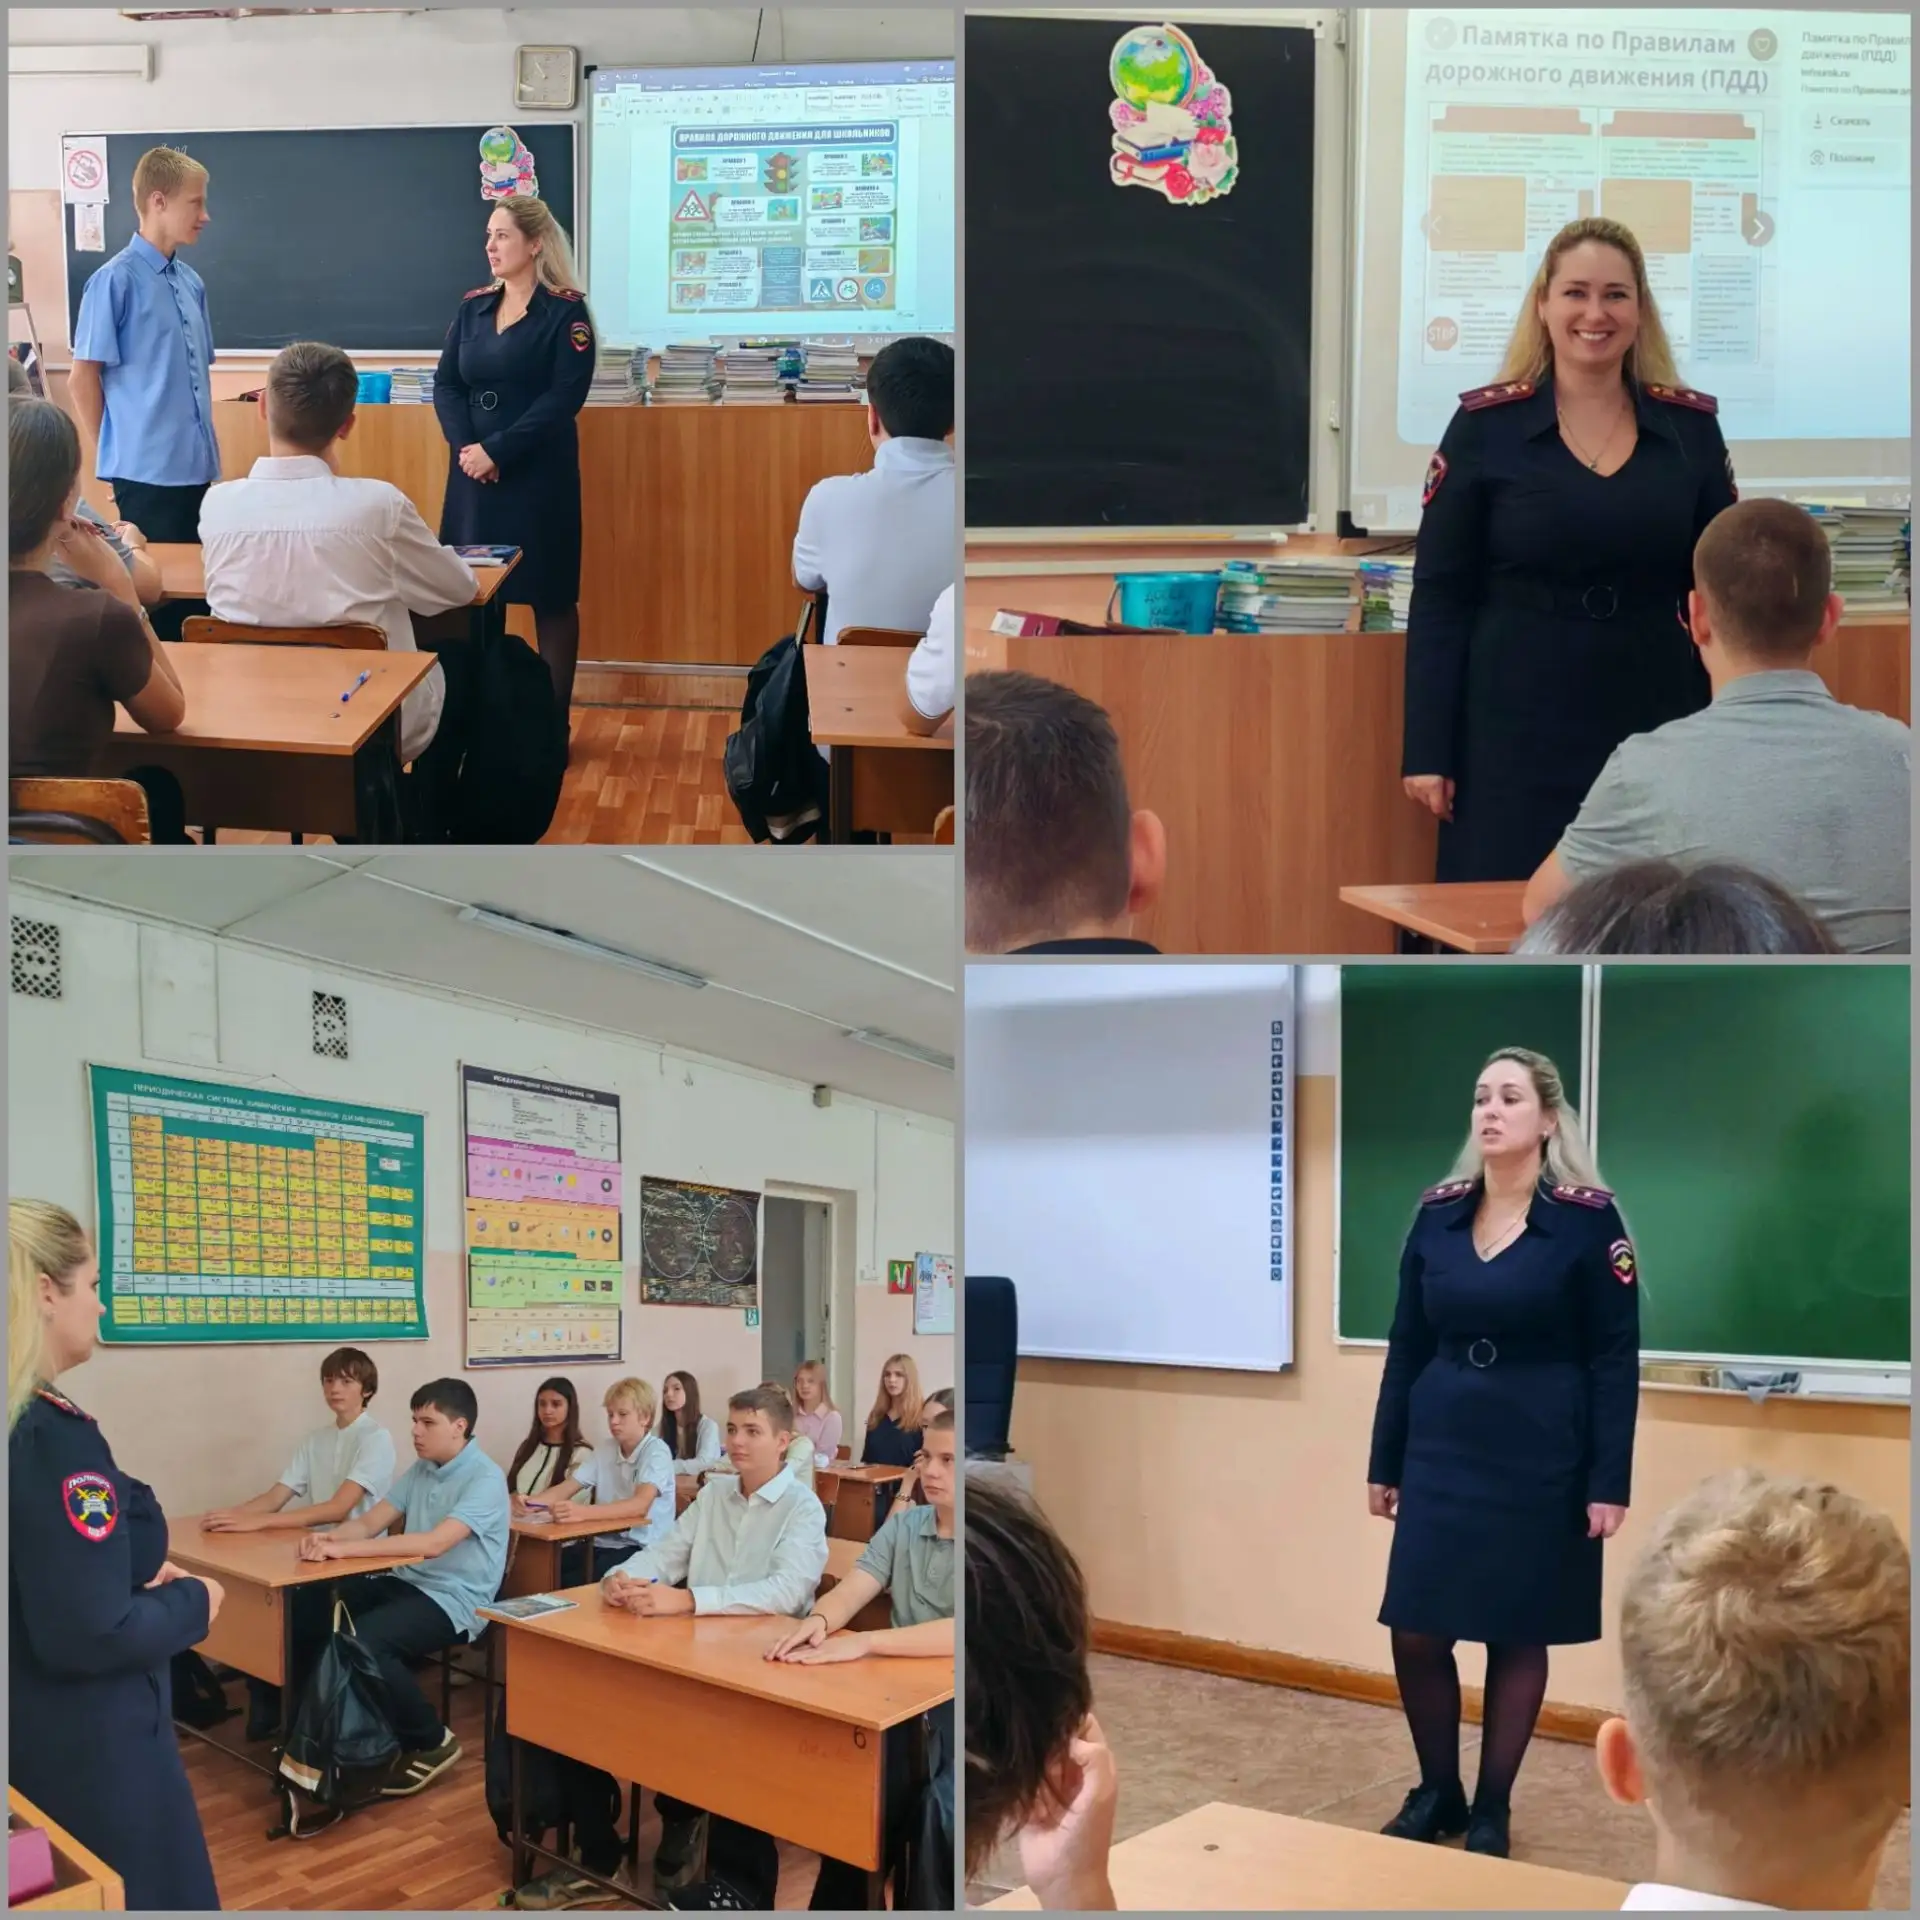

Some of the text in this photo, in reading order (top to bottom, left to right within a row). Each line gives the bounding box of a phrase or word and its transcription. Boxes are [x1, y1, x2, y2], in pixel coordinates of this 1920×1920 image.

[1462, 25, 1736, 56] Памятка по Правилам
[1425, 63, 1769, 94] дорожного движения (ПДД)
[679, 128, 890, 143] ПРАВИЛА ДОРОЖНОГО ДВИЖЕНИЯ ДЛЯ ШКОЛЬНИКОВ
[133, 1083, 204, 1101] ПЕРИОДИЧЕСКАЯ
[206, 1094, 244, 1106] СИСТЕМА
[853, 1725, 867, 1750] 6
